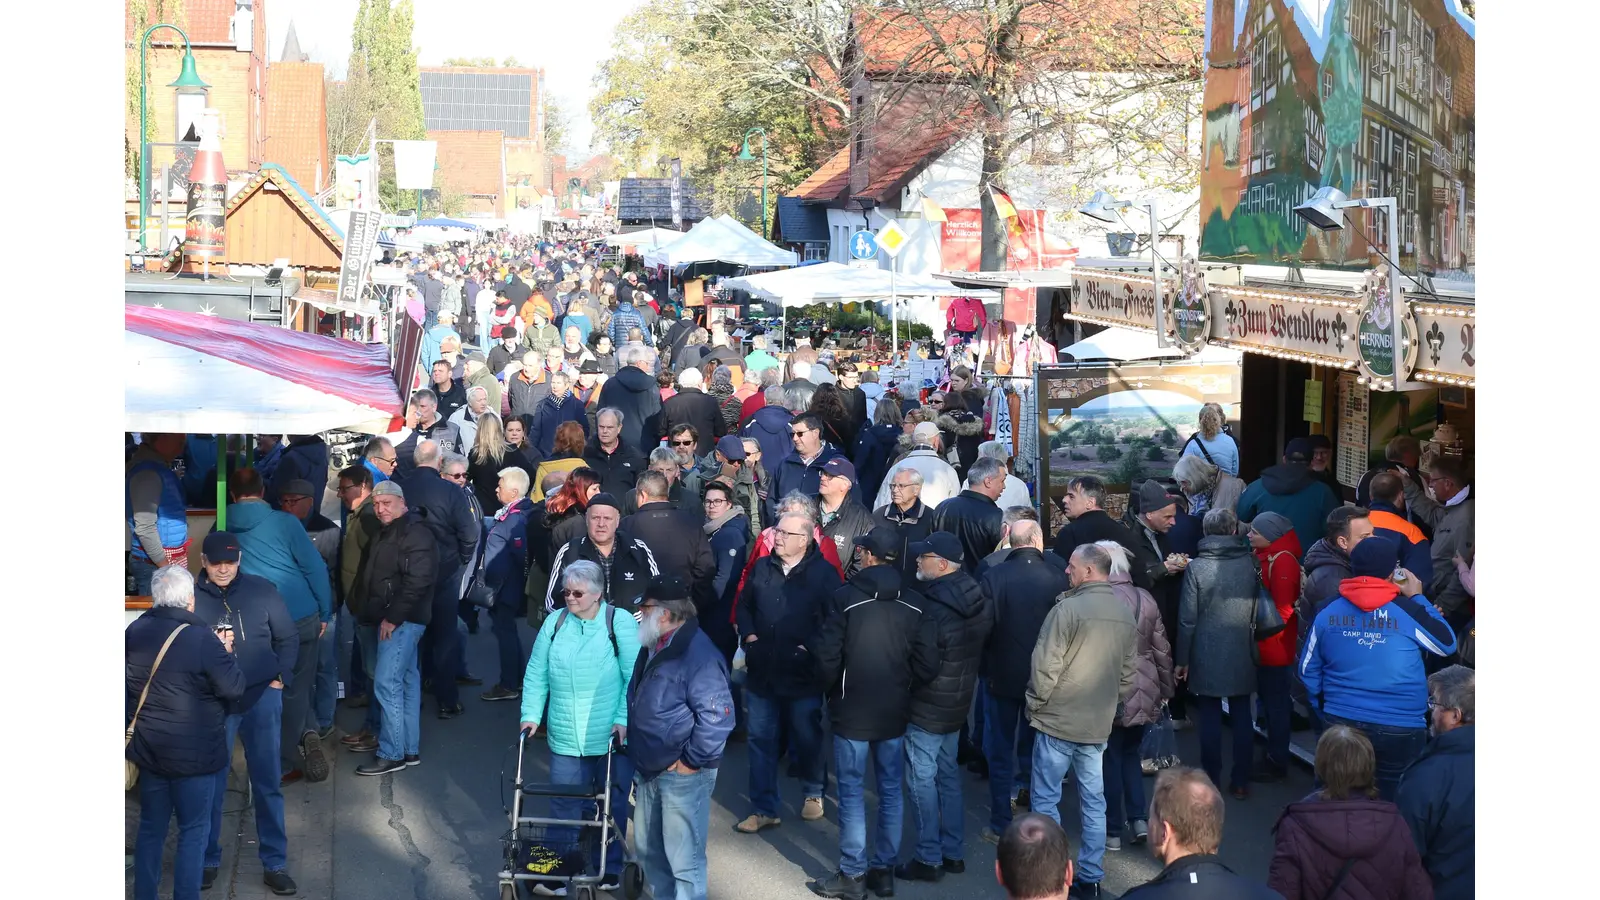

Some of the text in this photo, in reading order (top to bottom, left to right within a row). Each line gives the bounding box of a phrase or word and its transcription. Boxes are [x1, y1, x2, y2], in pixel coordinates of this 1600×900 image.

[946, 221, 977, 229] Herzlich
[945, 229, 982, 237] Willkom
[343, 213, 366, 300] Der Glühwein
[1086, 280, 1110, 312] Bier
[1123, 282, 1155, 320] Fass
[1238, 300, 1330, 345] Zum Wendler
[1329, 615, 1399, 630] BLUE LABEL
[1364, 631, 1382, 639] DAVID
